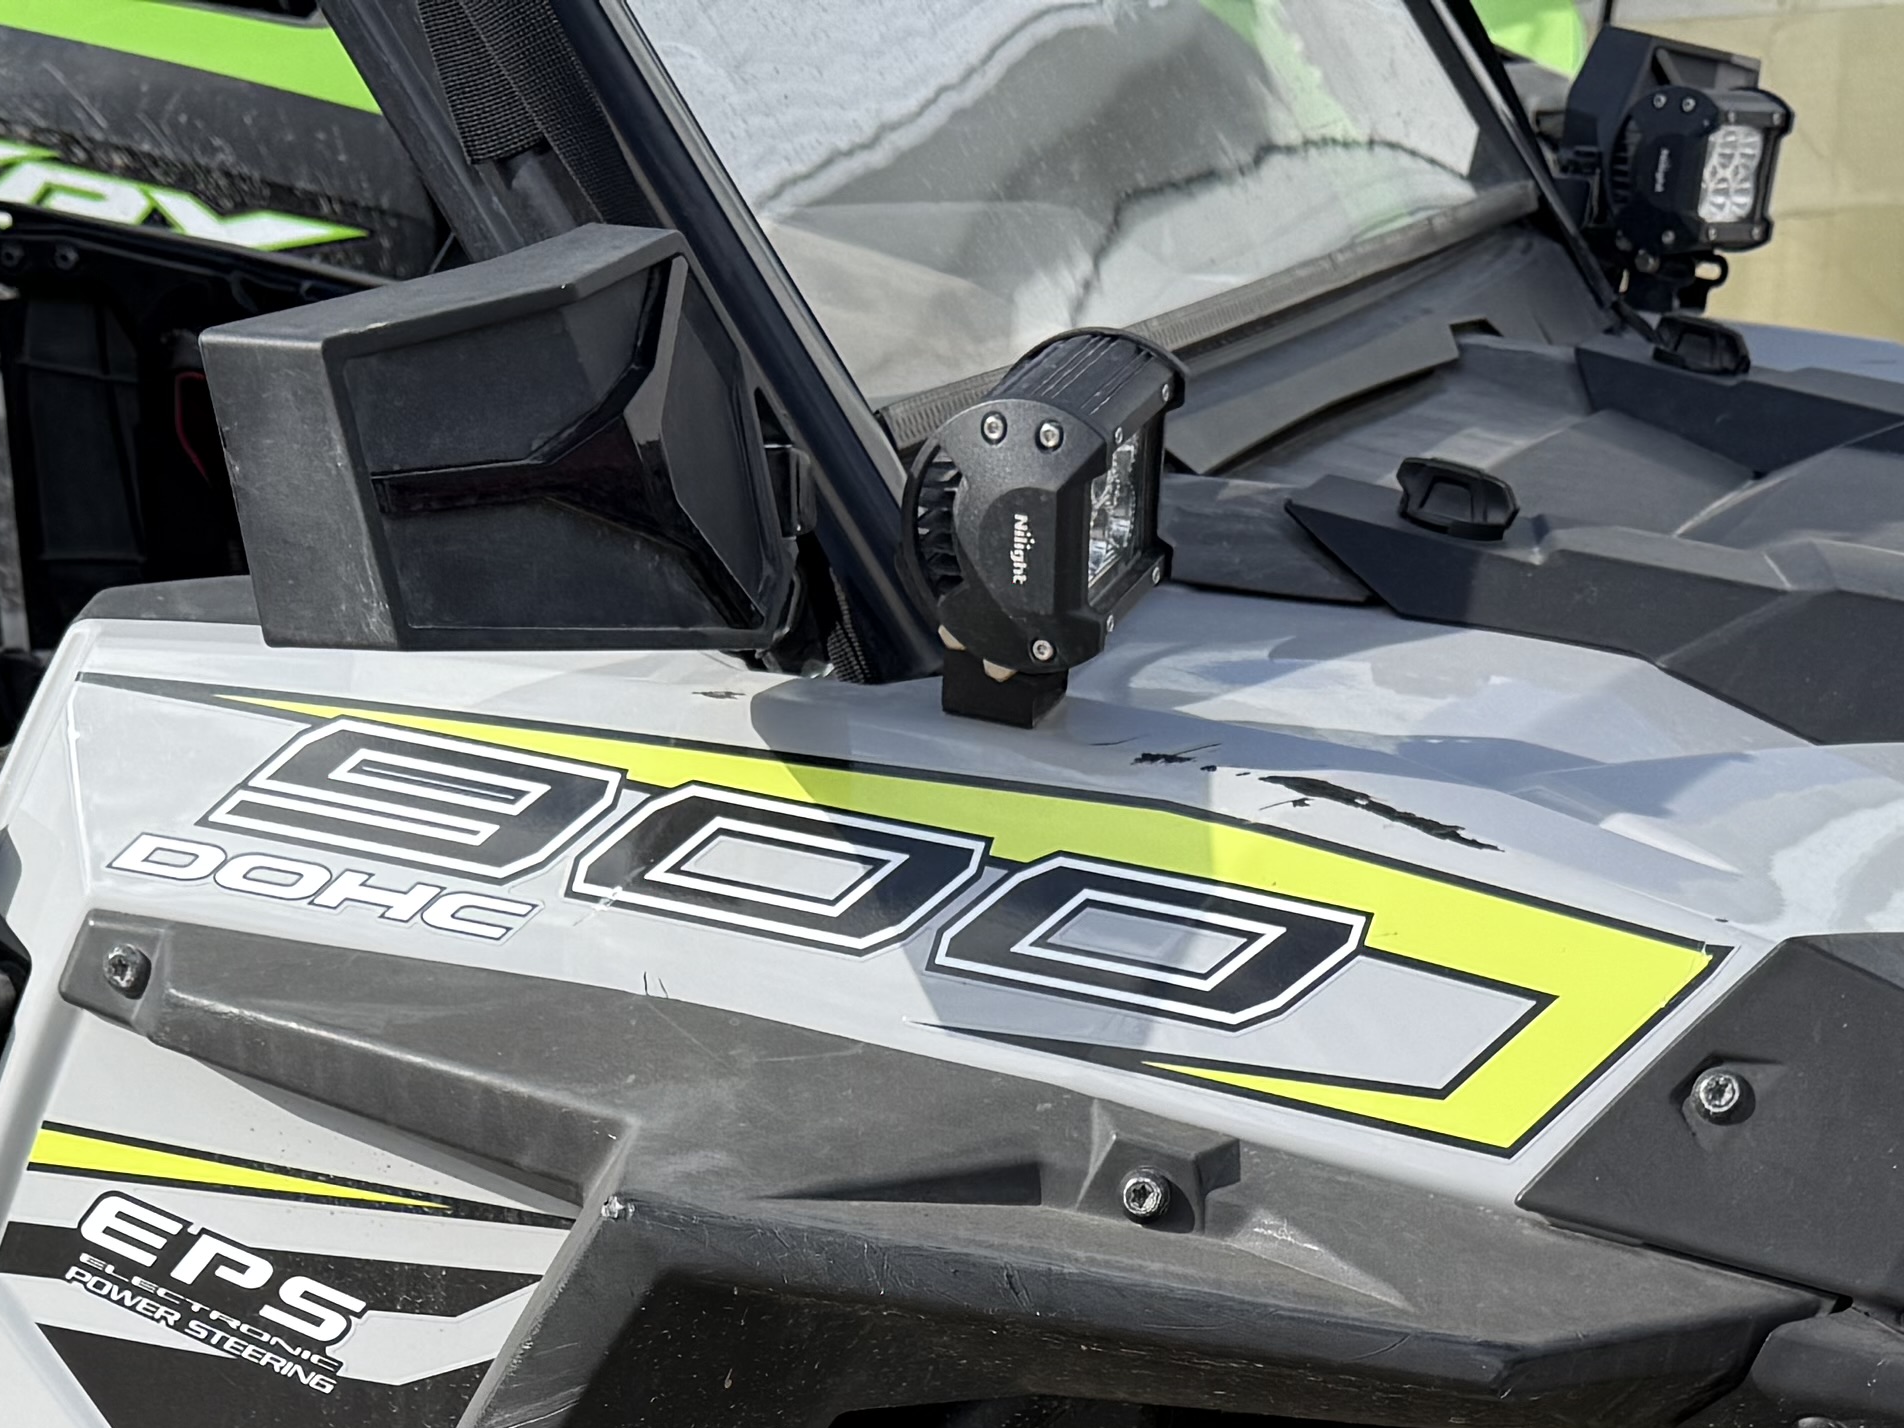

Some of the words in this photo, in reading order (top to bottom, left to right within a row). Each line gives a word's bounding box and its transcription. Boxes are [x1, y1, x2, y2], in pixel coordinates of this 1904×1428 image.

[1009, 513, 1036, 585] Nilight
[108, 831, 540, 941] DOHC
[194, 714, 1373, 1033] 900
[64, 1265, 183, 1328] POWER
[187, 1319, 335, 1395] STEERING
[80, 1195, 367, 1343] EPS
[80, 1252, 344, 1372] ELECTRONIC
